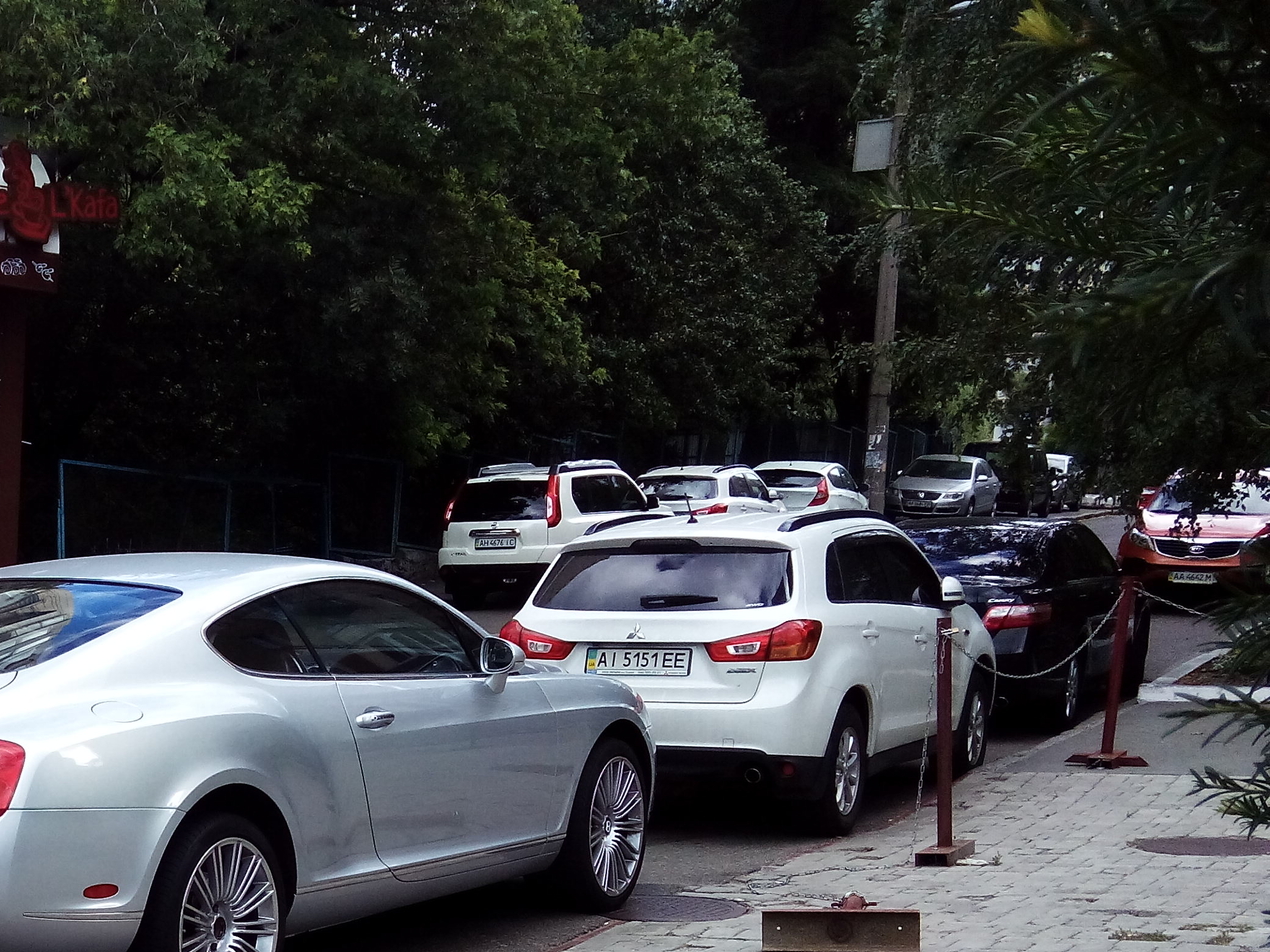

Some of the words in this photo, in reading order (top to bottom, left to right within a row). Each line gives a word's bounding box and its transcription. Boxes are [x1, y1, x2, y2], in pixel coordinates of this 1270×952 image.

[50, 187, 119, 218] L'Kafa
[597, 651, 617, 668] AI
[622, 651, 659, 668] 5151
[662, 652, 687, 669] EE
